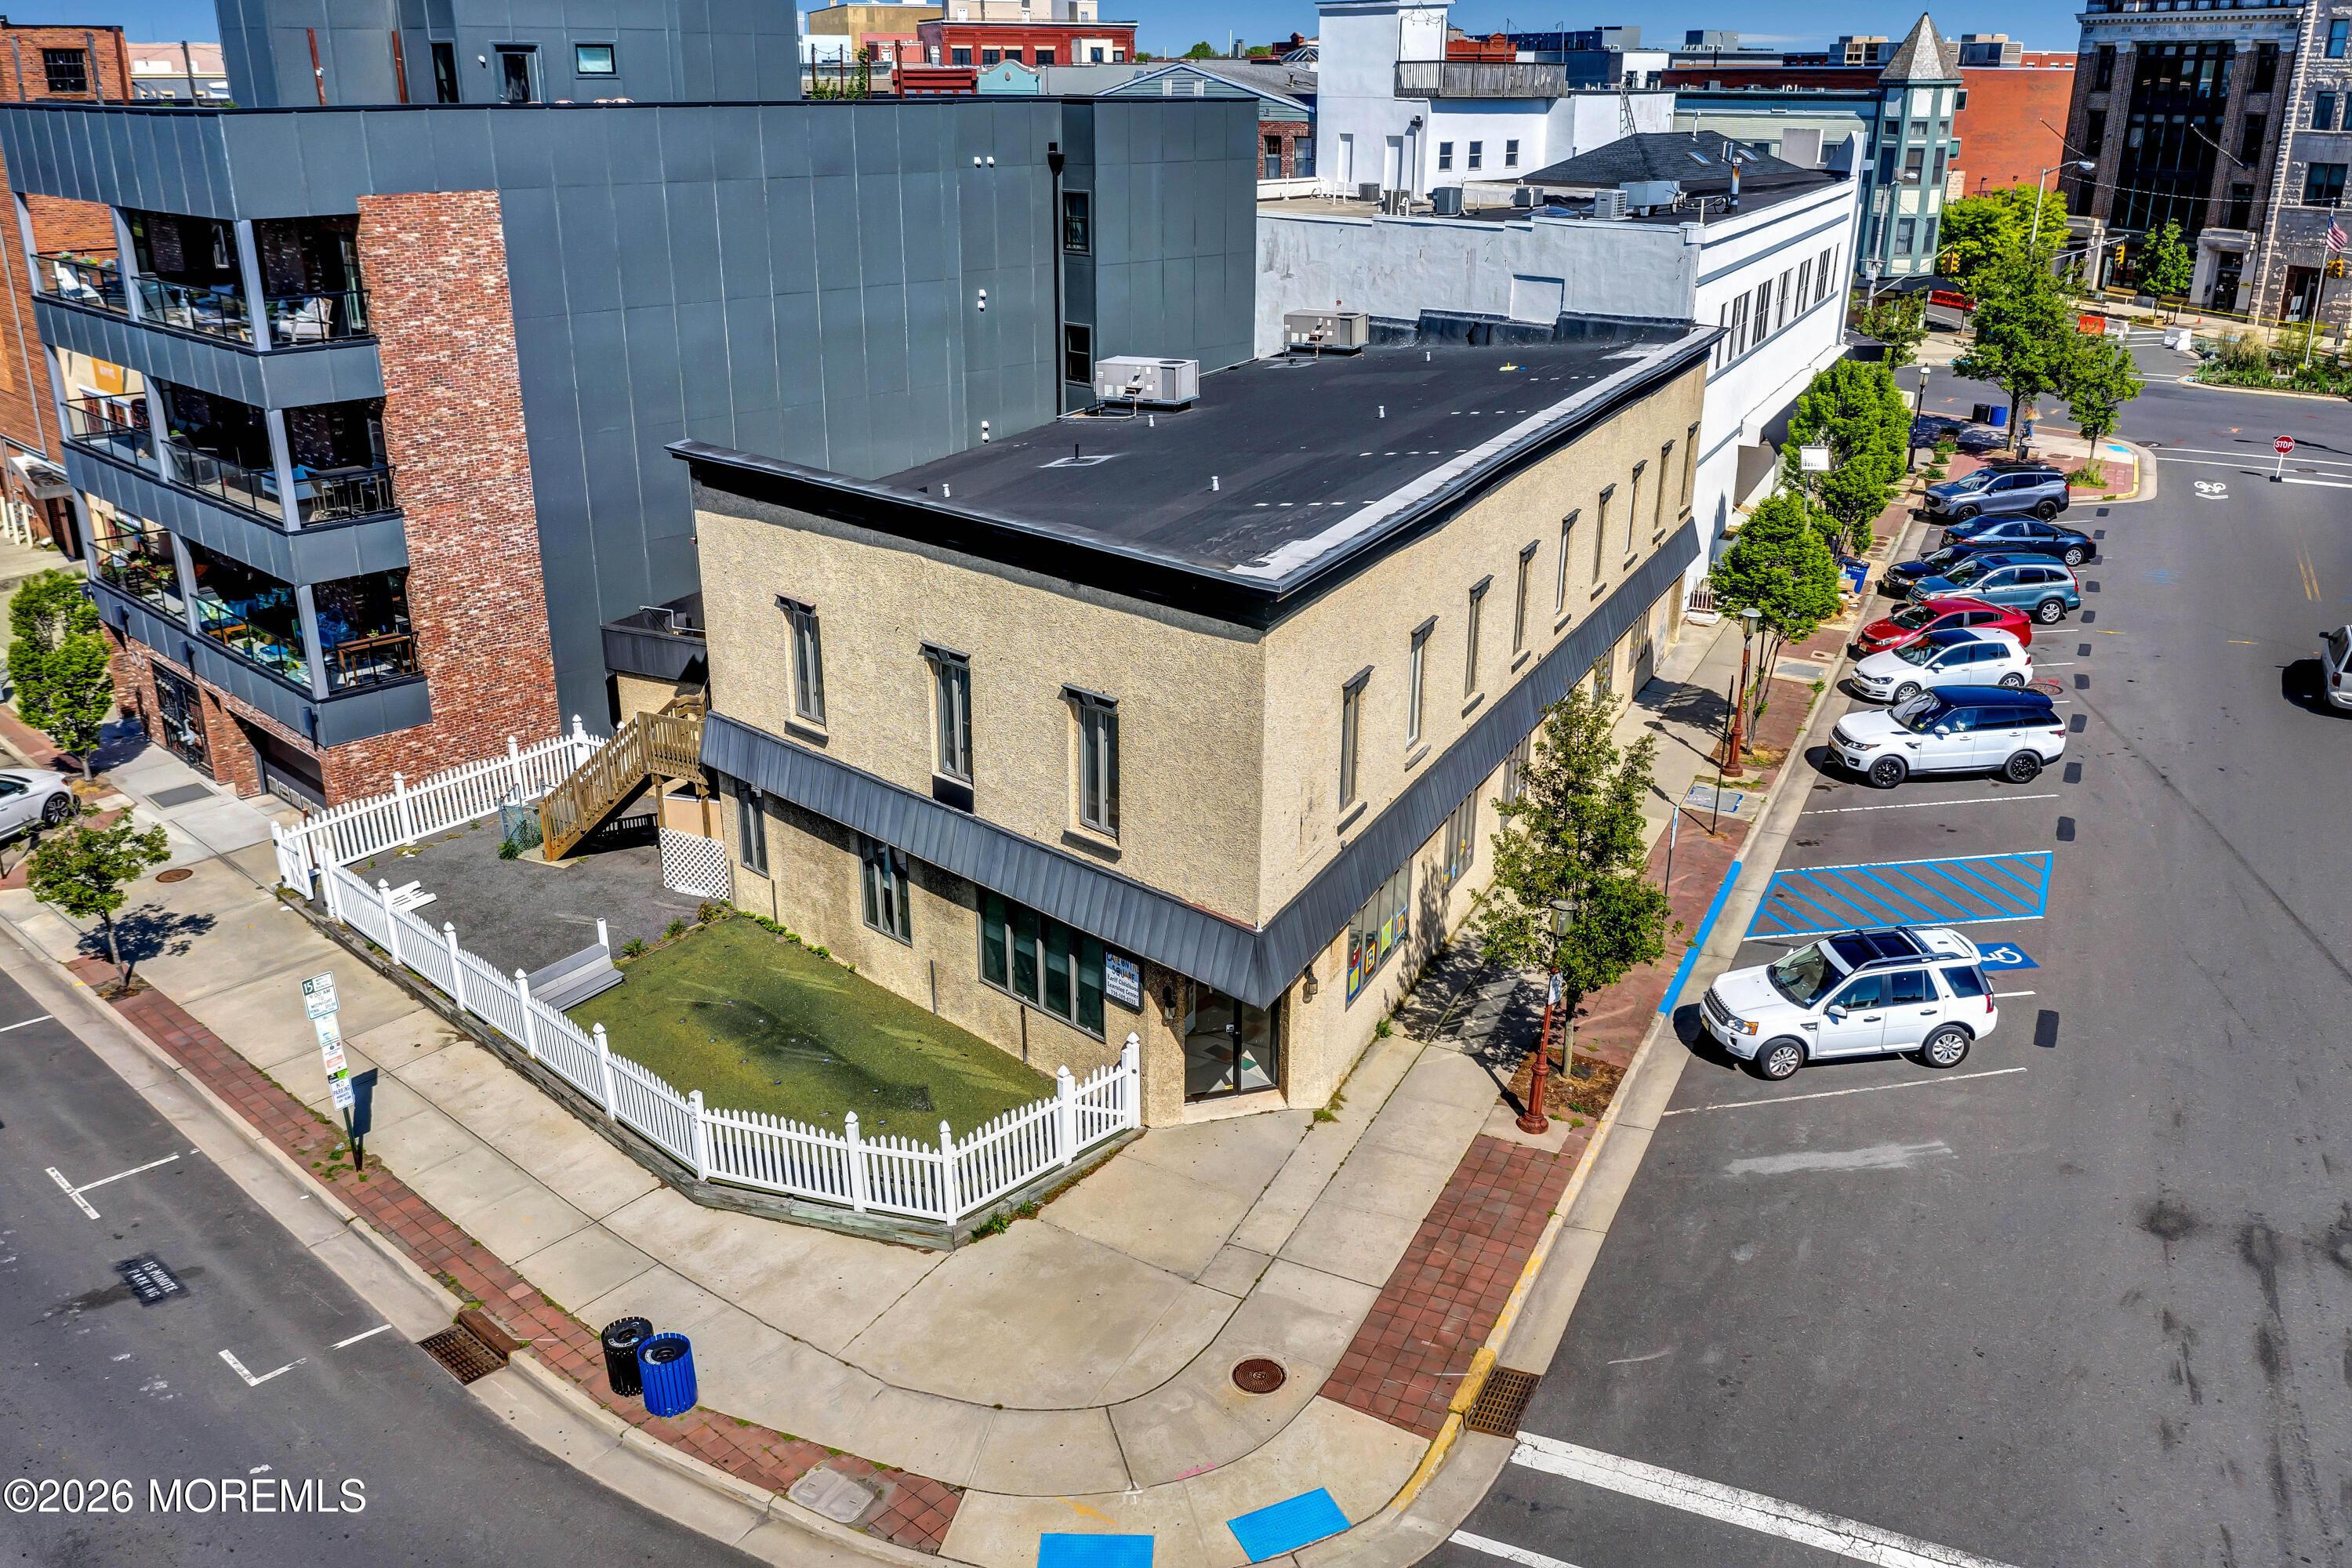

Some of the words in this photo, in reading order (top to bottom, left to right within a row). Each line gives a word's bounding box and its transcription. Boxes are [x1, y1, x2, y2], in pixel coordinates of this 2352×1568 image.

[2275, 440, 2293, 448] STOP
[1107, 974, 1118, 982] Early
[1112, 964, 1134, 983] SQUARE
[303, 982, 313, 993] 15
[1107, 981, 1125, 993] Learning
[1126, 989, 1139, 1000] Center
[311, 998, 332, 1008] MIDNIGHT
[333, 1085, 350, 1095] PARKING
[141, 1261, 158, 1271] 15
[127, 1269, 161, 1298] PARKING
[148, 1269, 180, 1293] MINUTE
